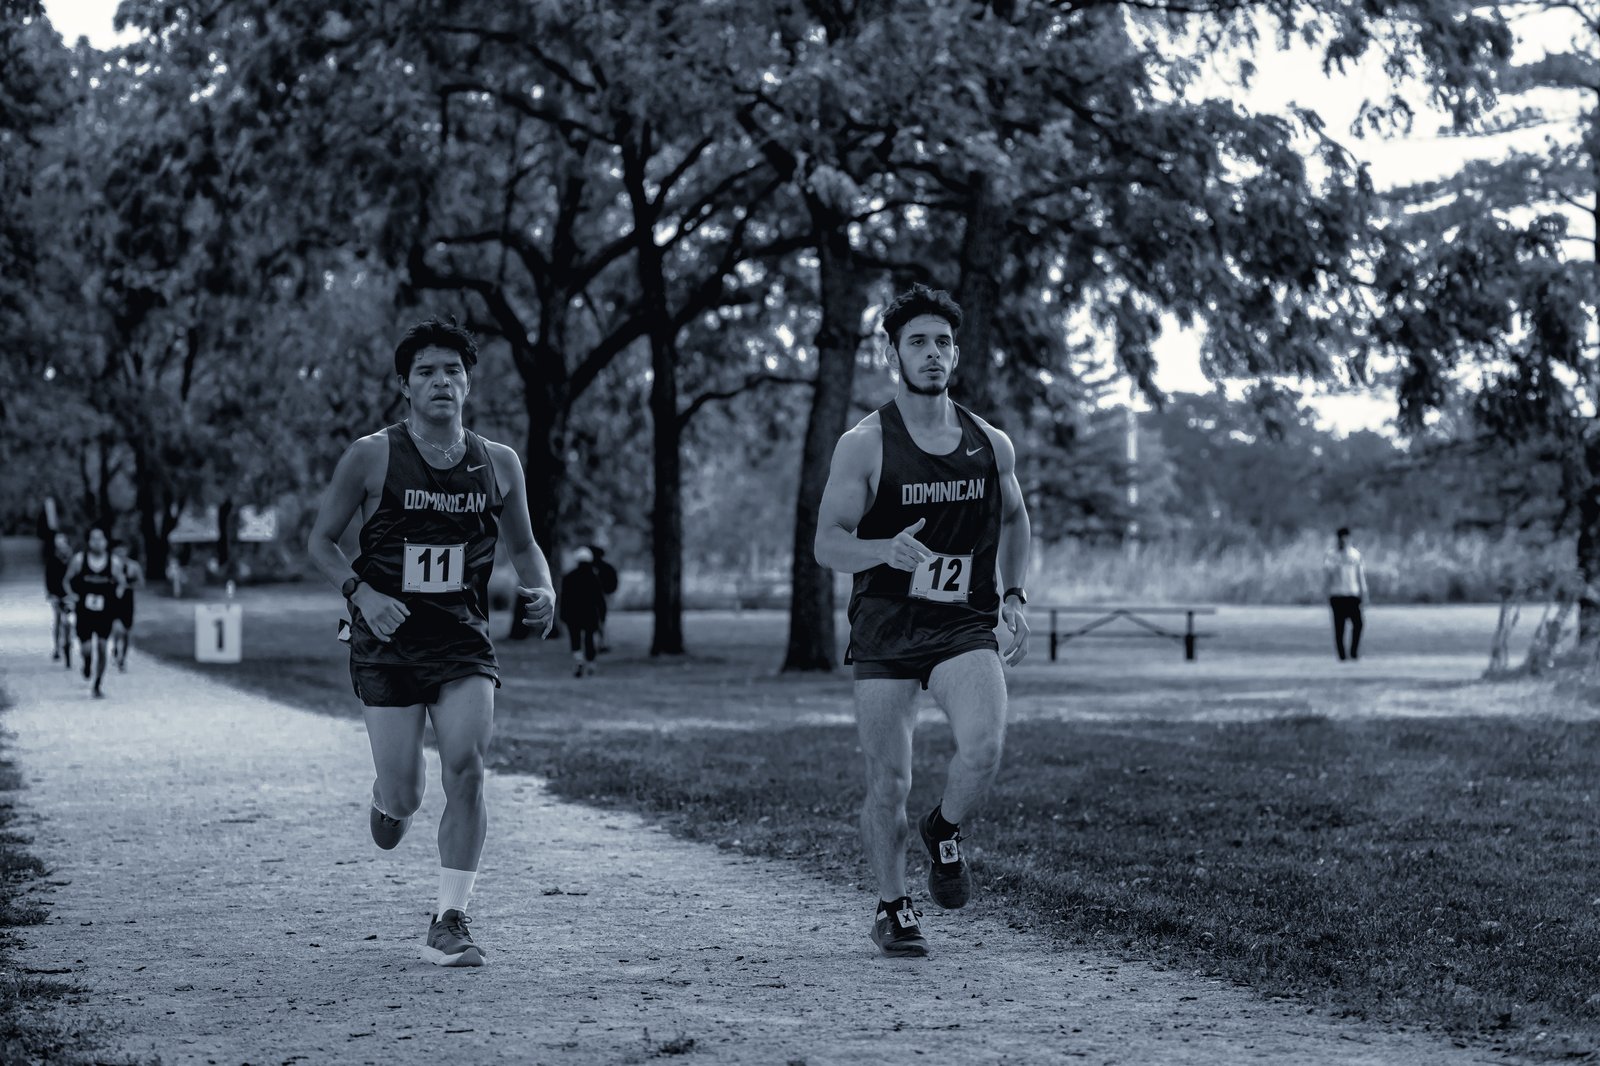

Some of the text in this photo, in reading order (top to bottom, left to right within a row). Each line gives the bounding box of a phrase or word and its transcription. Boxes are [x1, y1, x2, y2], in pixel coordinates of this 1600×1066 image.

[404, 489, 487, 513] DOMINICAN
[902, 478, 985, 505] DOMINICAN
[418, 548, 450, 582] 11
[928, 557, 963, 591] 12
[212, 618, 225, 651] 1
